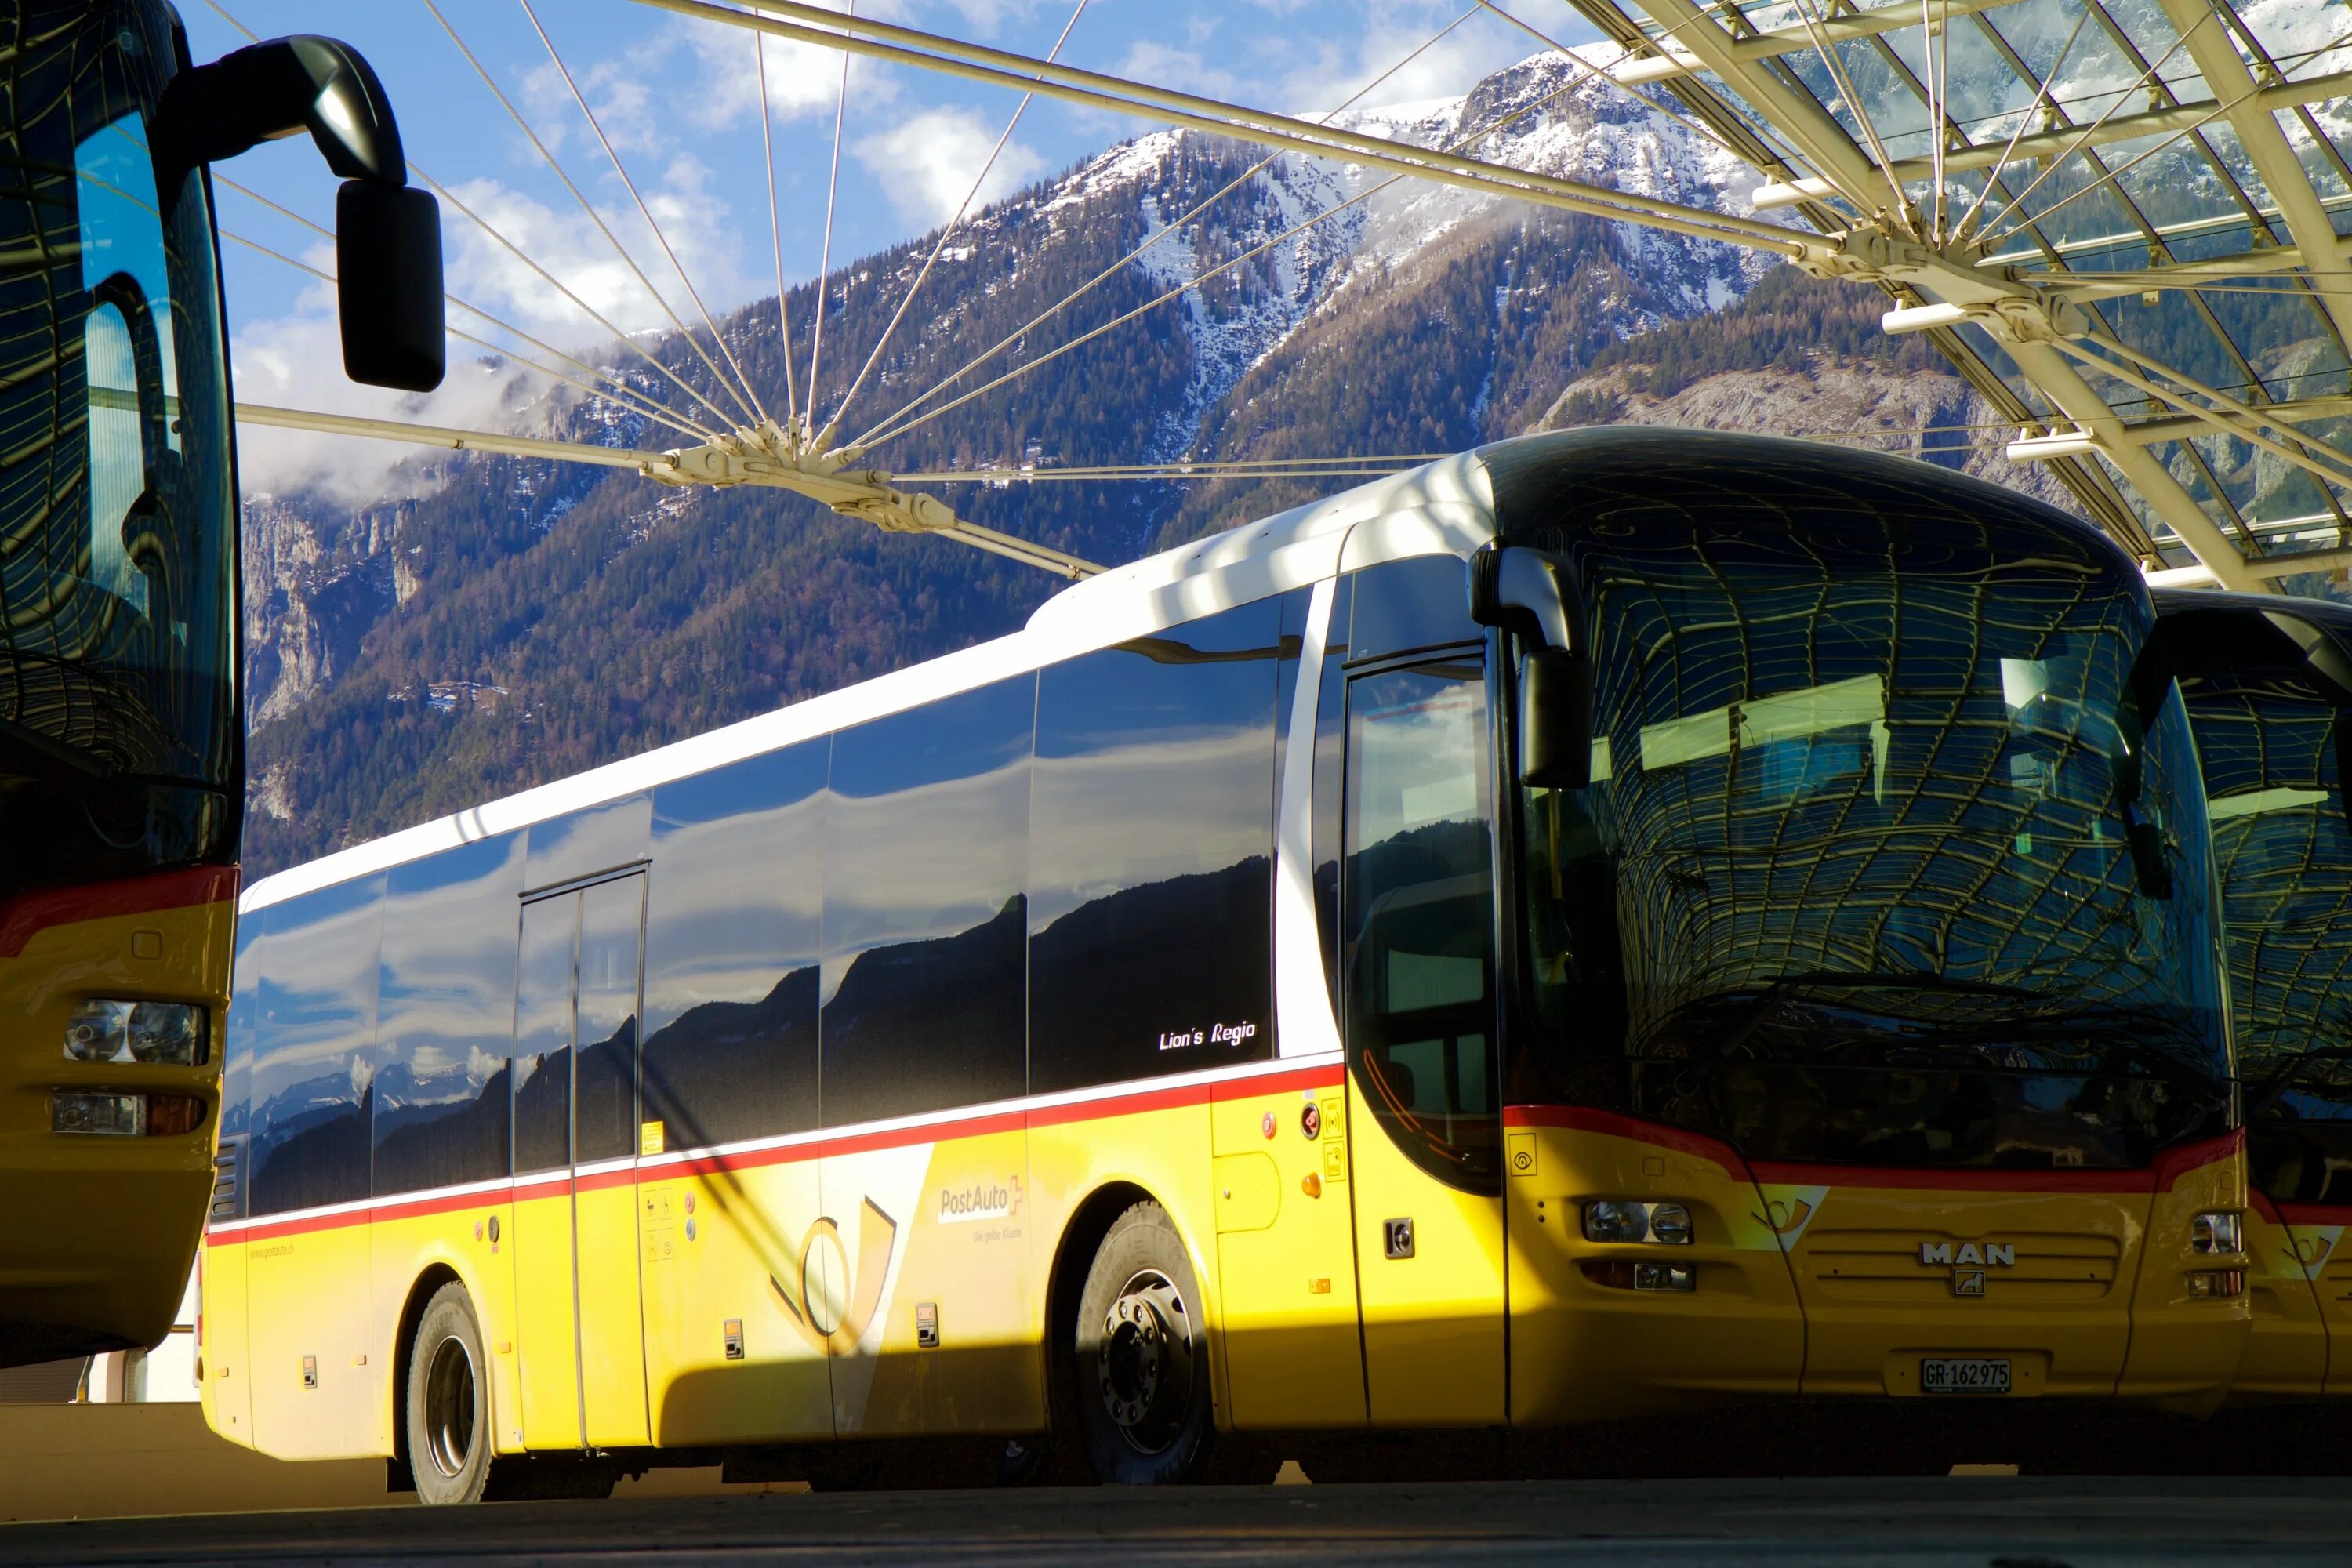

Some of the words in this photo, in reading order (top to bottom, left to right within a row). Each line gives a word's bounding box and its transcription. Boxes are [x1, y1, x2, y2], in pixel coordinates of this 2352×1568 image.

[1159, 1027, 1203, 1051] Lion's
[1210, 1020, 1256, 1047] Regio
[941, 1185, 1007, 1216] PostAuto
[1922, 1242, 2015, 1265] MAN
